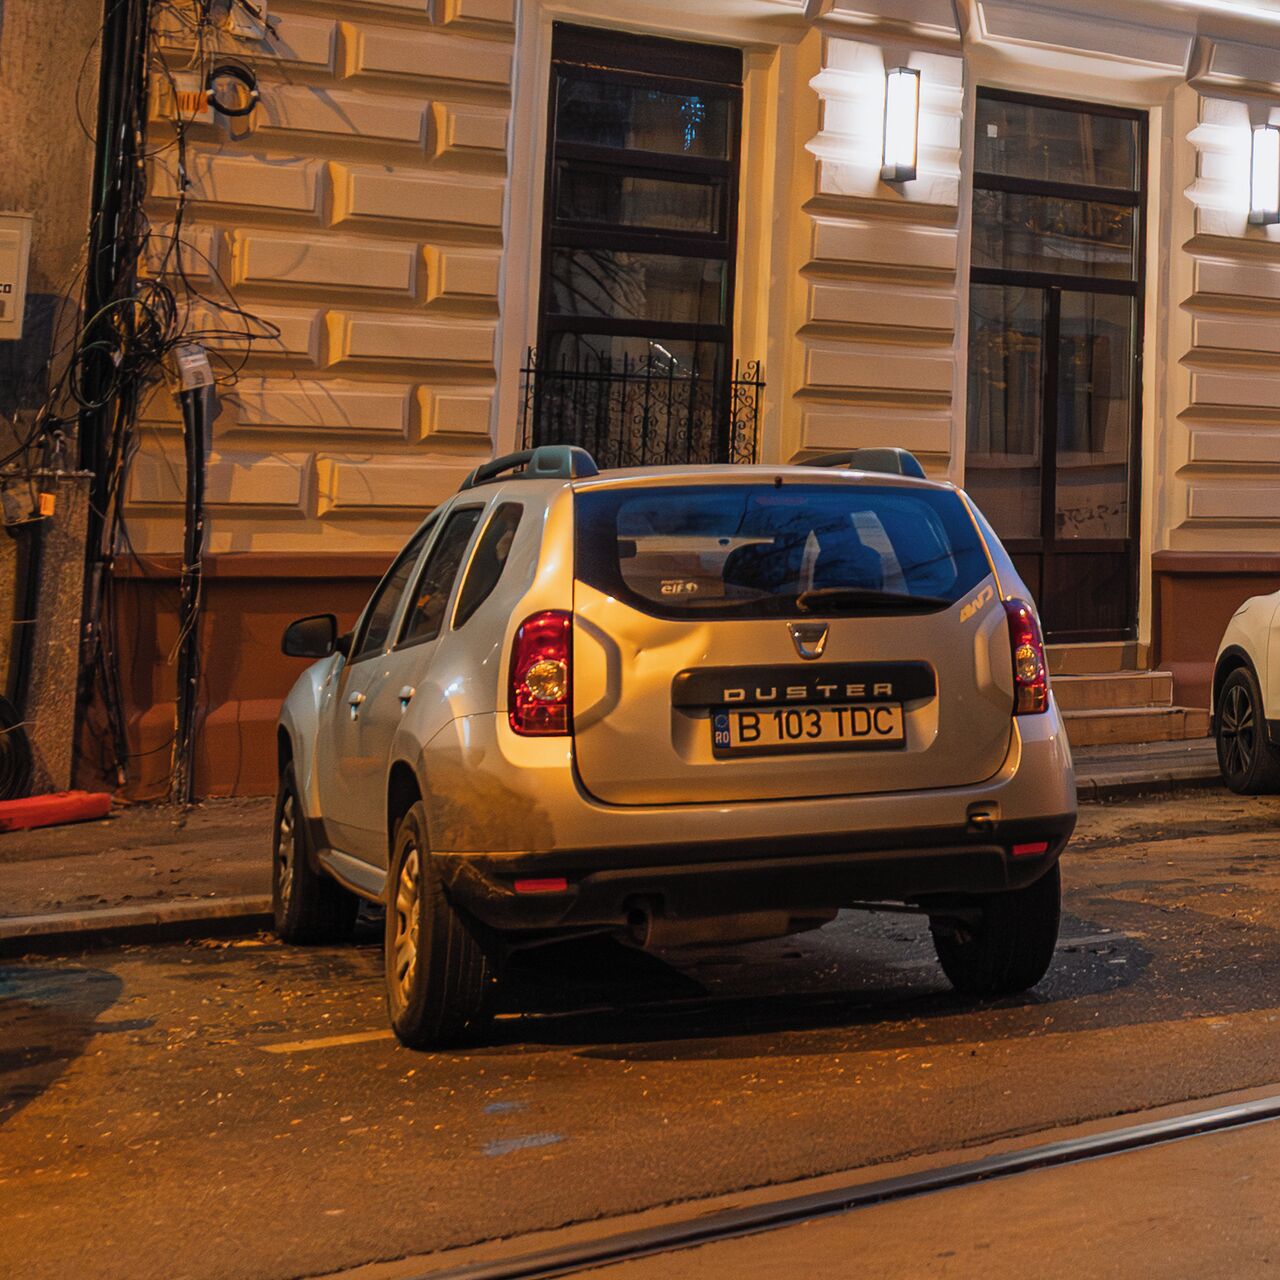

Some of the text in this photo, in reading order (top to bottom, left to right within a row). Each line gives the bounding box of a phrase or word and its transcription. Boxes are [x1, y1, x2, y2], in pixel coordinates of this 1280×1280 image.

[723, 683, 893, 702] DUSTER
[738, 706, 894, 743] B 103 TDC
[715, 730, 730, 744] RO
